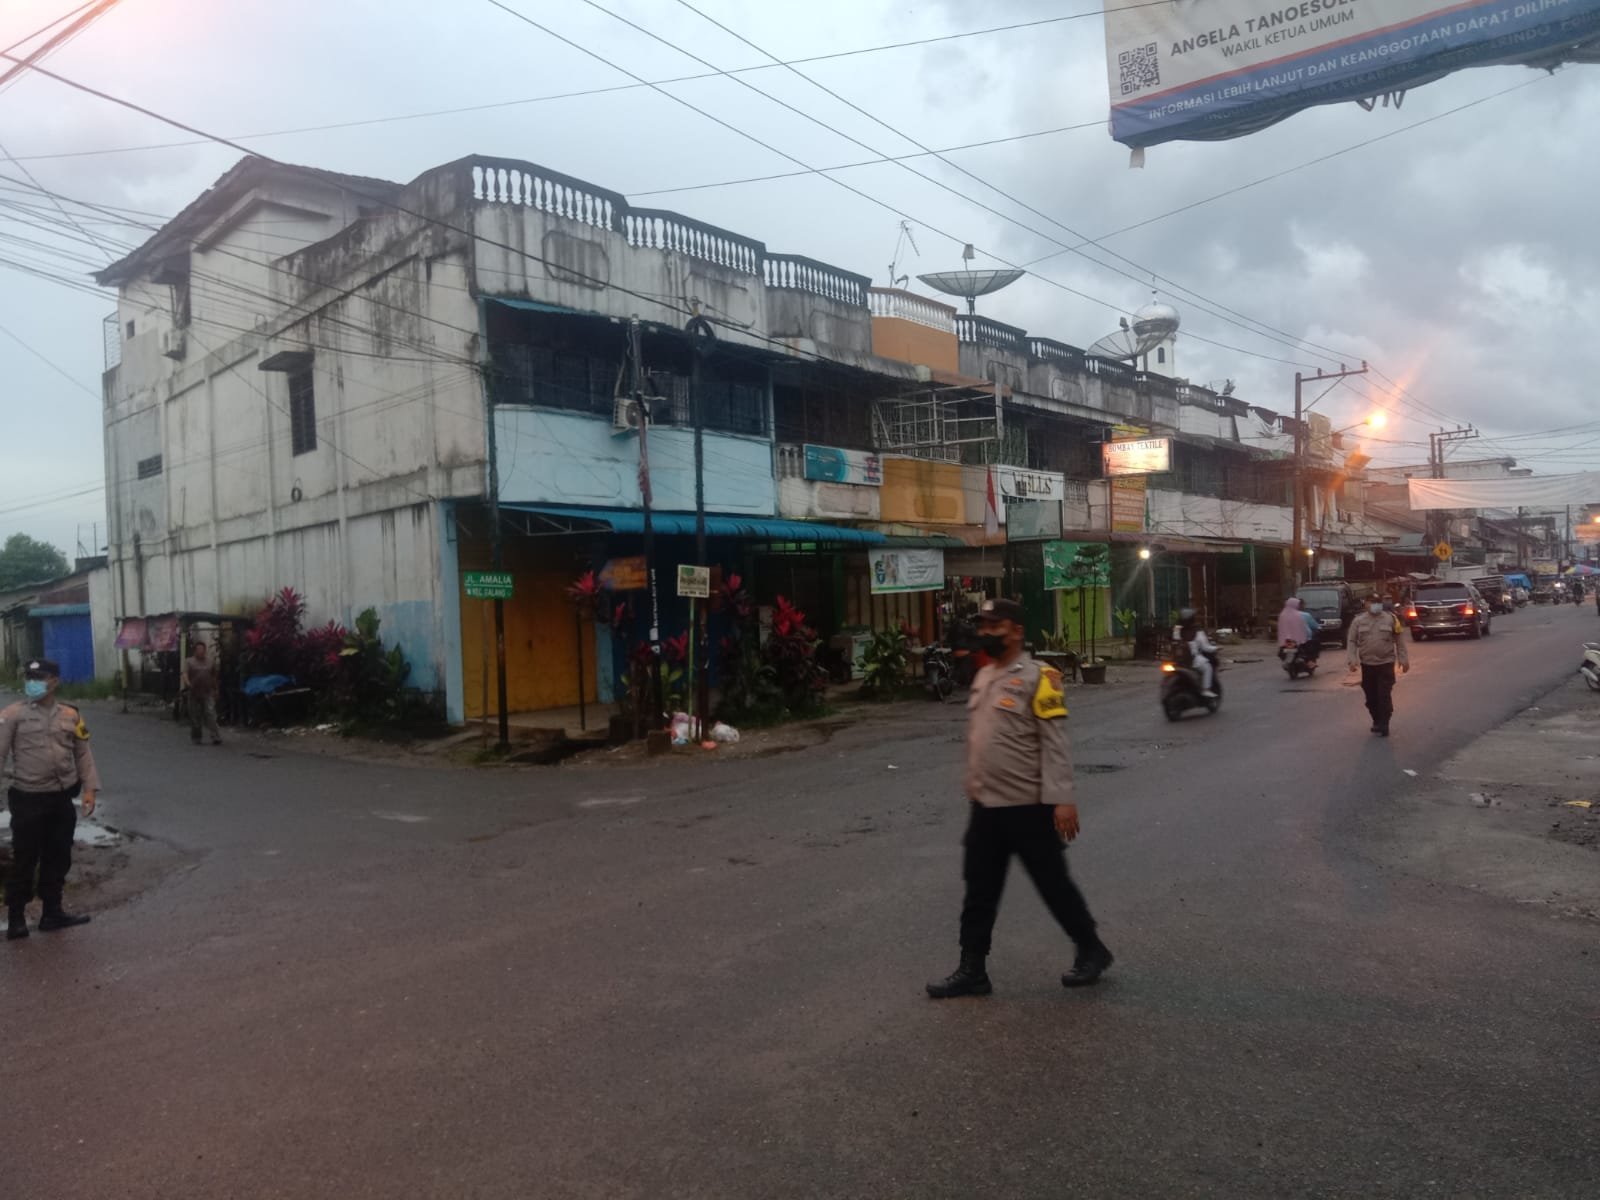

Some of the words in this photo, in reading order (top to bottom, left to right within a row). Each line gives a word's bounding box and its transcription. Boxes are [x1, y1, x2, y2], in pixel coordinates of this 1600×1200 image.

[1170, 24, 1241, 57] ANGELA
[1245, 0, 1356, 33] TANOESO
[1221, 39, 1261, 57] WAKIL
[1265, 27, 1307, 45] KETUA
[1310, 9, 1354, 32] UMUM
[1149, 91, 1214, 120] INFORMASI
[1218, 82, 1251, 99] LEBIH
[1255, 68, 1303, 91] LANJUT
[1308, 59, 1337, 77] DAN
[1341, 25, 1451, 66] KEANGGOTAAN
[1456, 9, 1510, 34] DAPAT
[480, 575, 512, 585] AMALIA
